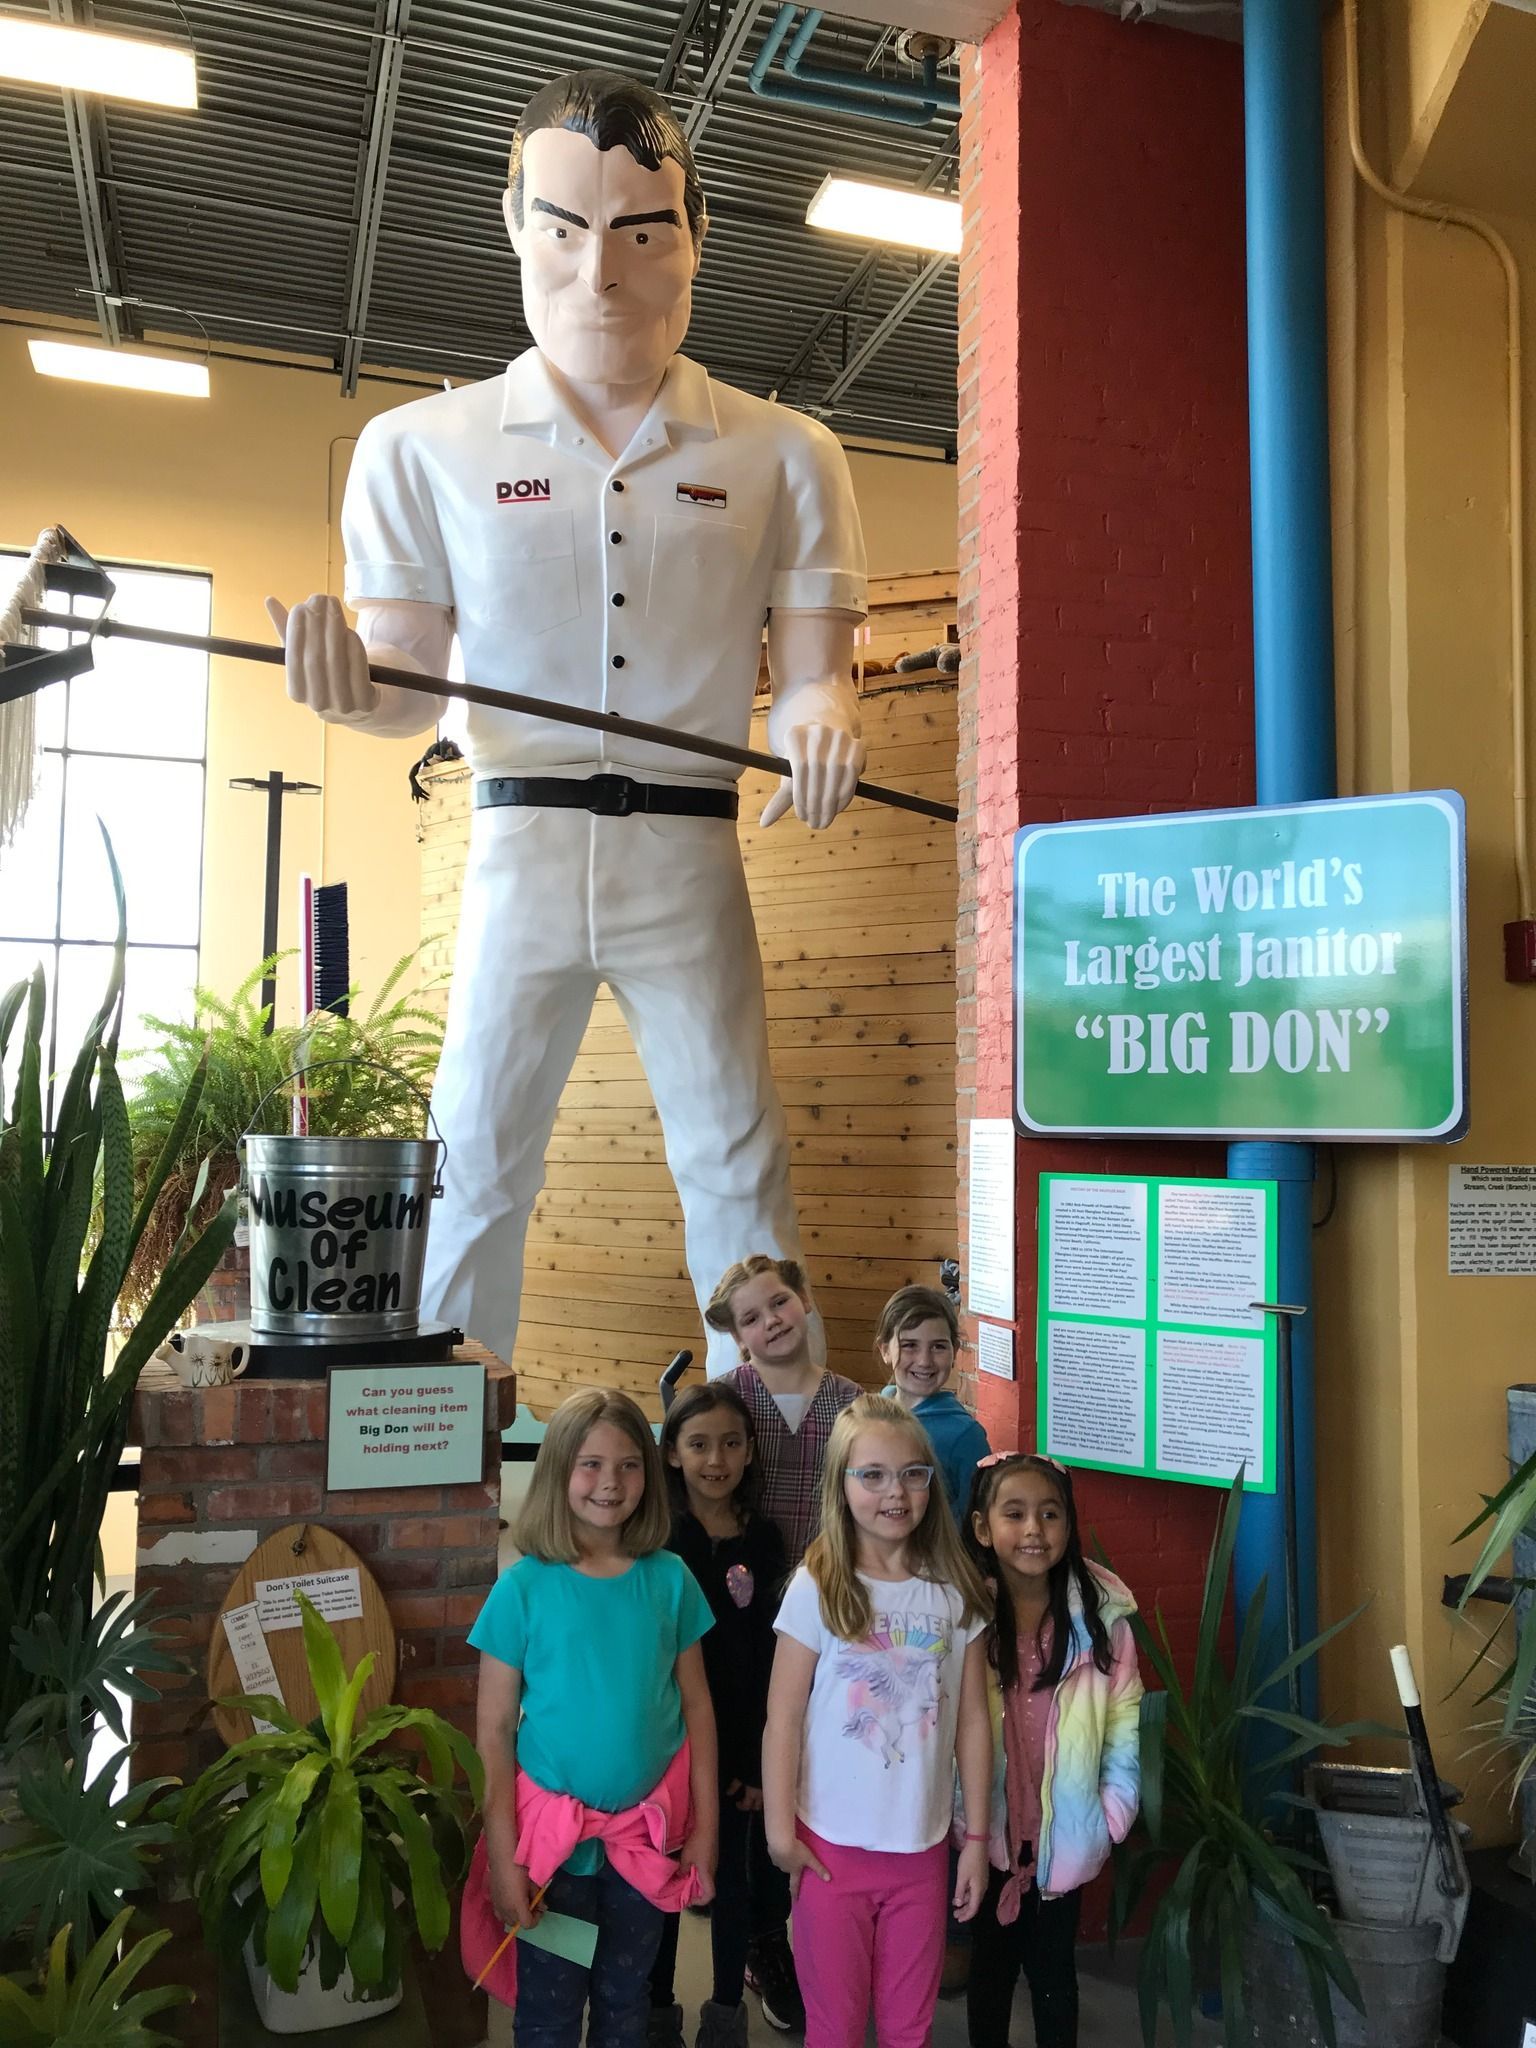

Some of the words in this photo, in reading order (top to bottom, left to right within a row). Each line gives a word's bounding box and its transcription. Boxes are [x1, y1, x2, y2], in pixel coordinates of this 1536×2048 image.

[496, 479, 550, 499] DON
[1098, 872, 1176, 919] The
[1192, 857, 1363, 913] World’s
[1064, 934, 1222, 989] Largest
[1234, 928, 1402, 987] Janitor
[1461, 1166, 1479, 1174] Hand
[1481, 1166, 1509, 1174] Powered
[1512, 1166, 1531, 1174] Water
[249, 1189, 425, 1230] Museum
[310, 1230, 368, 1269] Of
[269, 1257, 400, 1313] Clean
[362, 1388, 386, 1397] Can
[390, 1387, 413, 1399] you
[417, 1386, 454, 1398] guess
[346, 1406, 378, 1417] what
[383, 1404, 436, 1415] cleaning
[440, 1403, 468, 1413] item
[360, 1425, 380, 1437] Big
[385, 1424, 408, 1434] Don
[413, 1422, 434, 1433] will
[439, 1422, 454, 1431] be
[363, 1443, 410, 1454] holding
[414, 1441, 449, 1451] next?
[266, 1581, 290, 1592] Don's
[292, 1579, 314, 1589] Toilet
[317, 1573, 350, 1585] Suitcase
